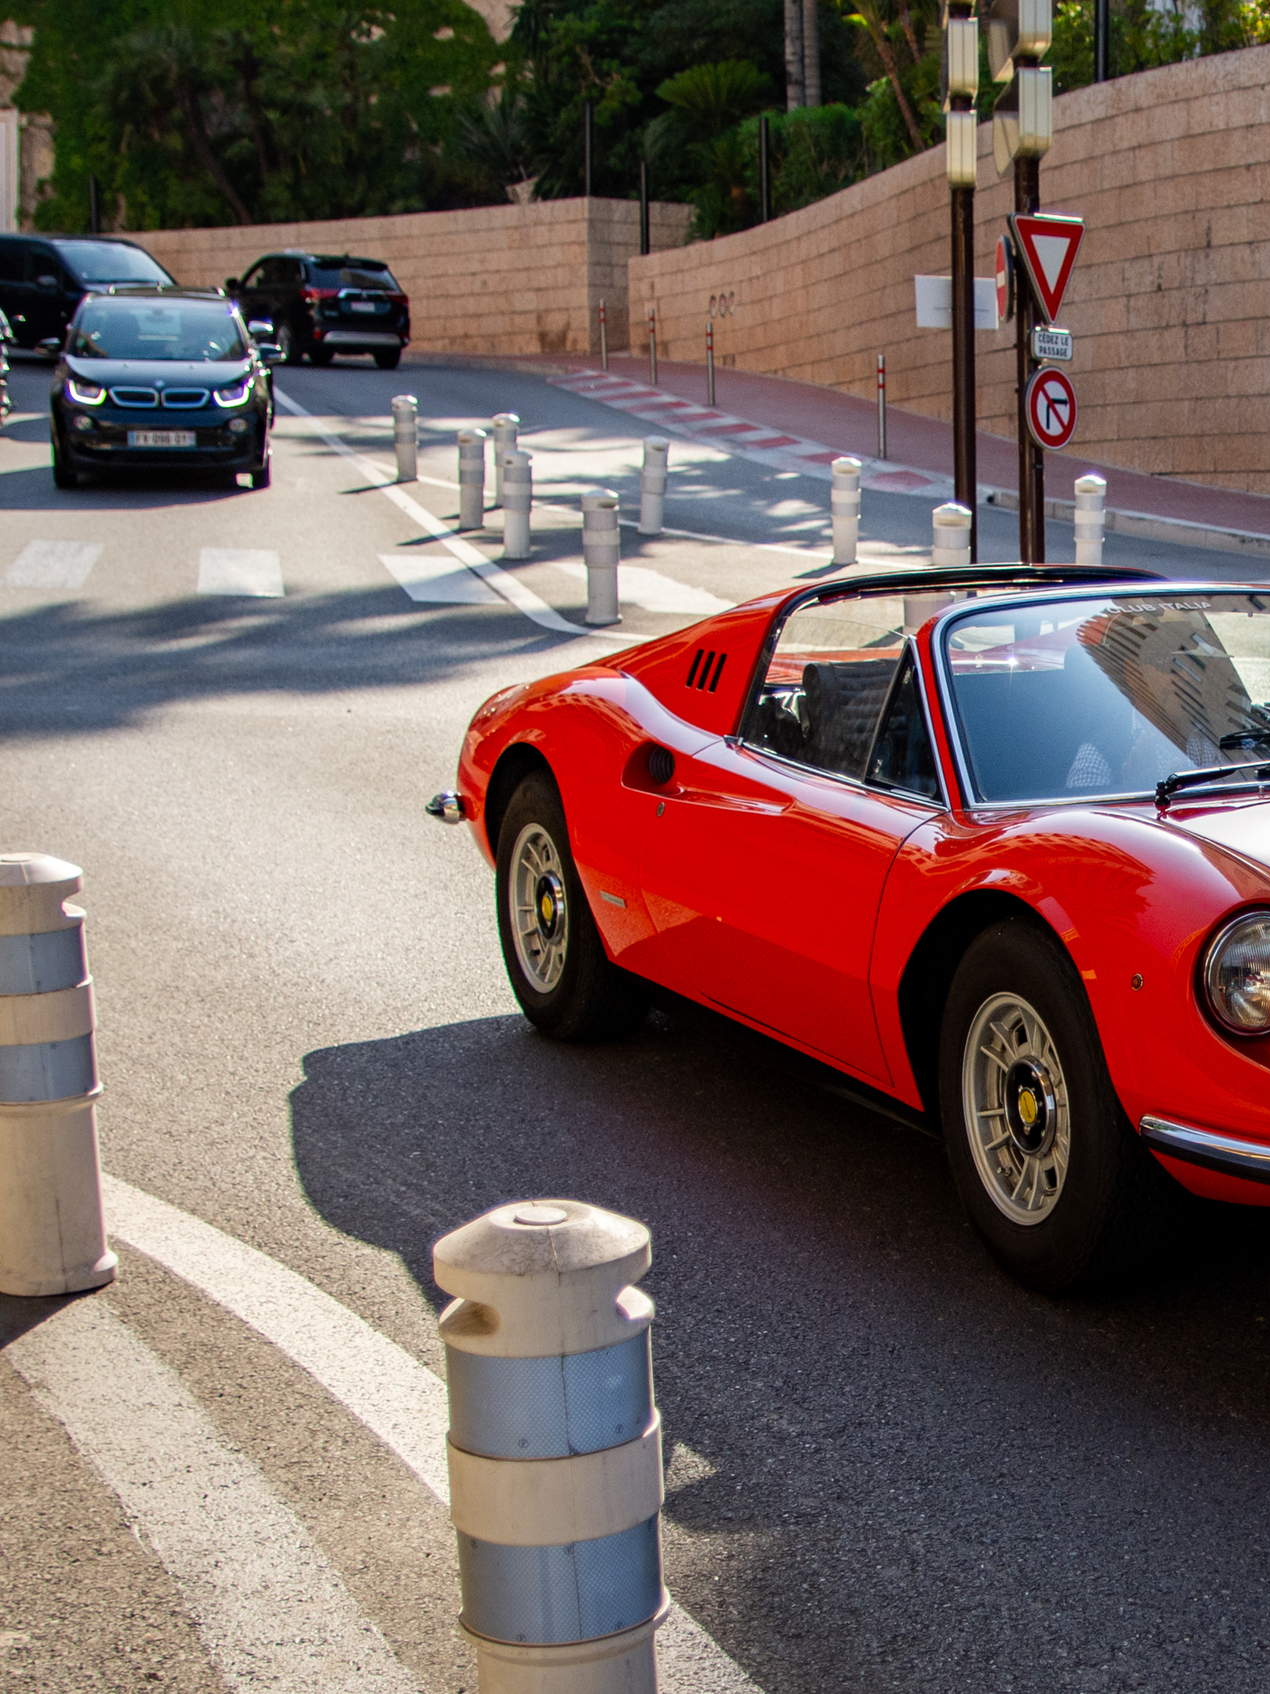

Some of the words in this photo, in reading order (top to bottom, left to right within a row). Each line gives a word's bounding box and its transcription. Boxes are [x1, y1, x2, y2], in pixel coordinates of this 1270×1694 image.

[1038, 333, 1059, 345] CÉDEZ
[1061, 336, 1068, 346] LE
[1039, 346, 1067, 357] PASSAGE
[1106, 604, 1156, 614] CLUB
[1159, 601, 1212, 611] ITALIA
